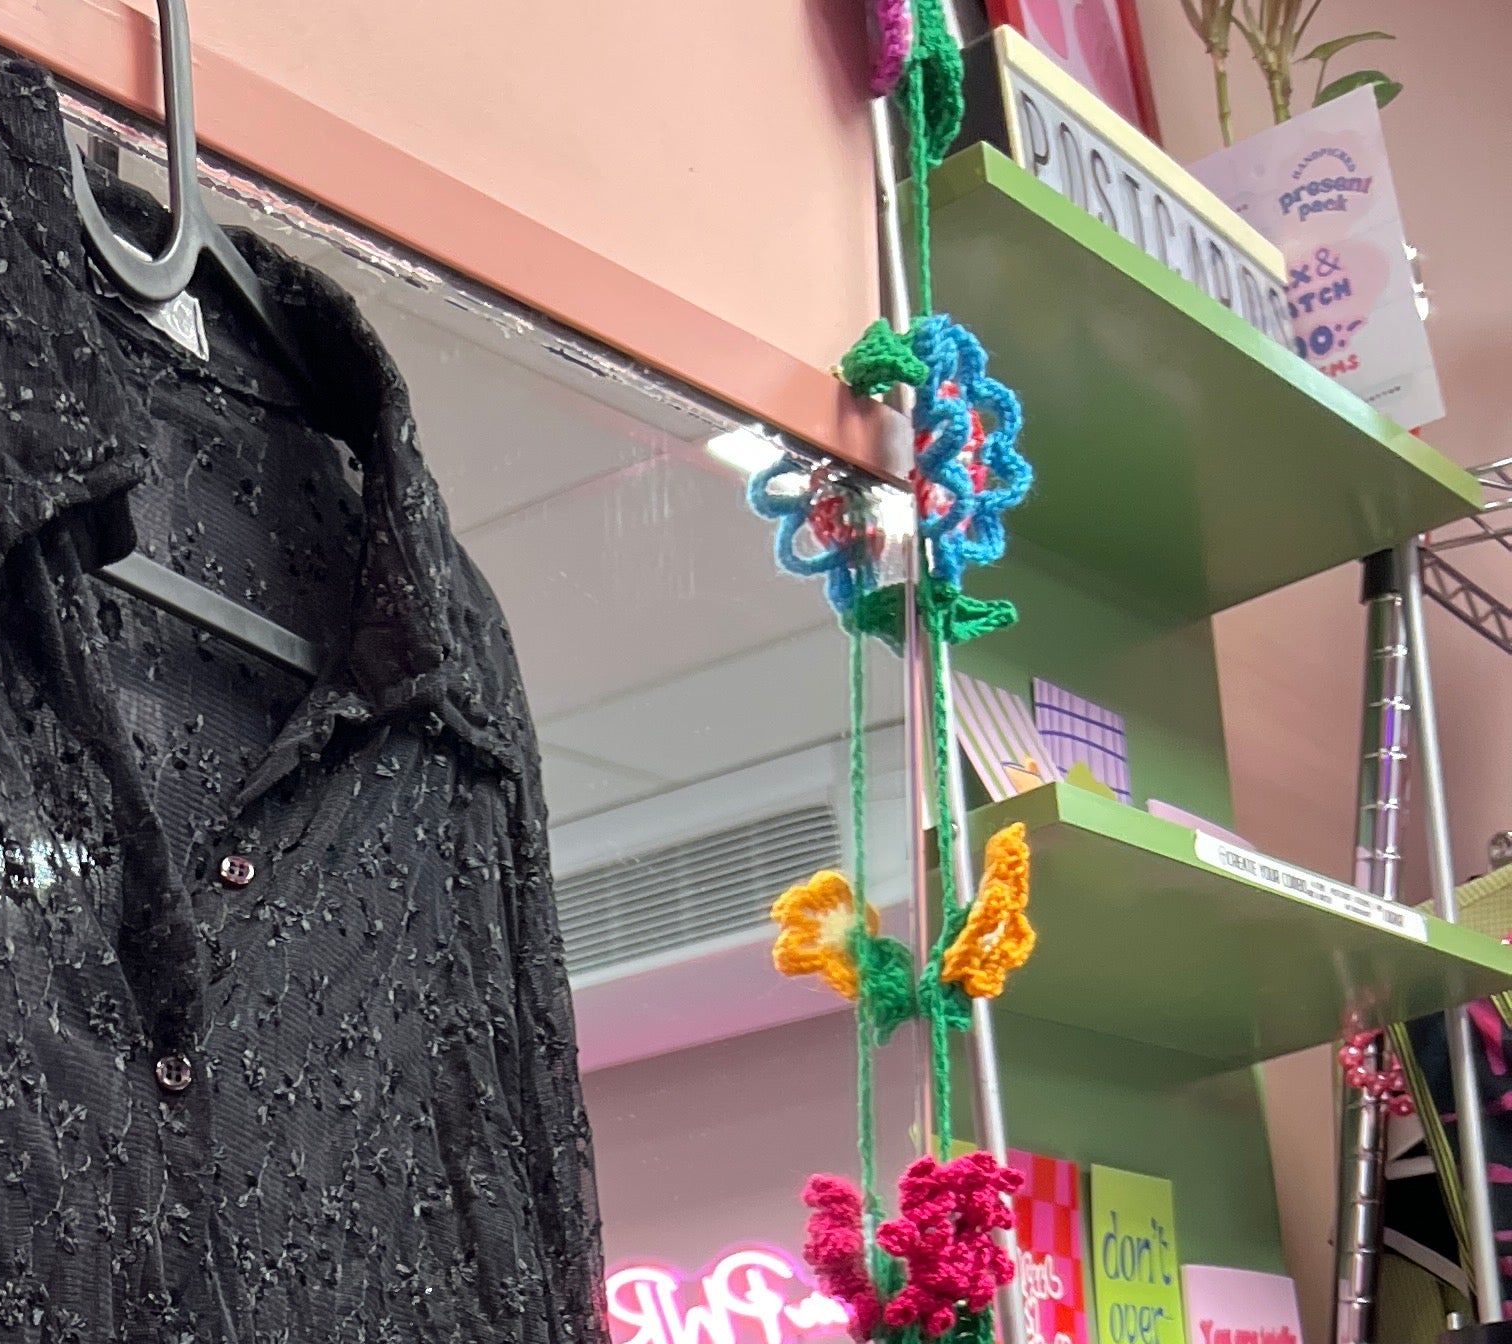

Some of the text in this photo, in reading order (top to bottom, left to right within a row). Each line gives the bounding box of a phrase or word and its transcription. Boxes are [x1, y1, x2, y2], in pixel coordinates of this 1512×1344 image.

[1279, 176, 1373, 216] present
[1298, 194, 1348, 222] pack
[1102, 1210, 1173, 1286] don't
